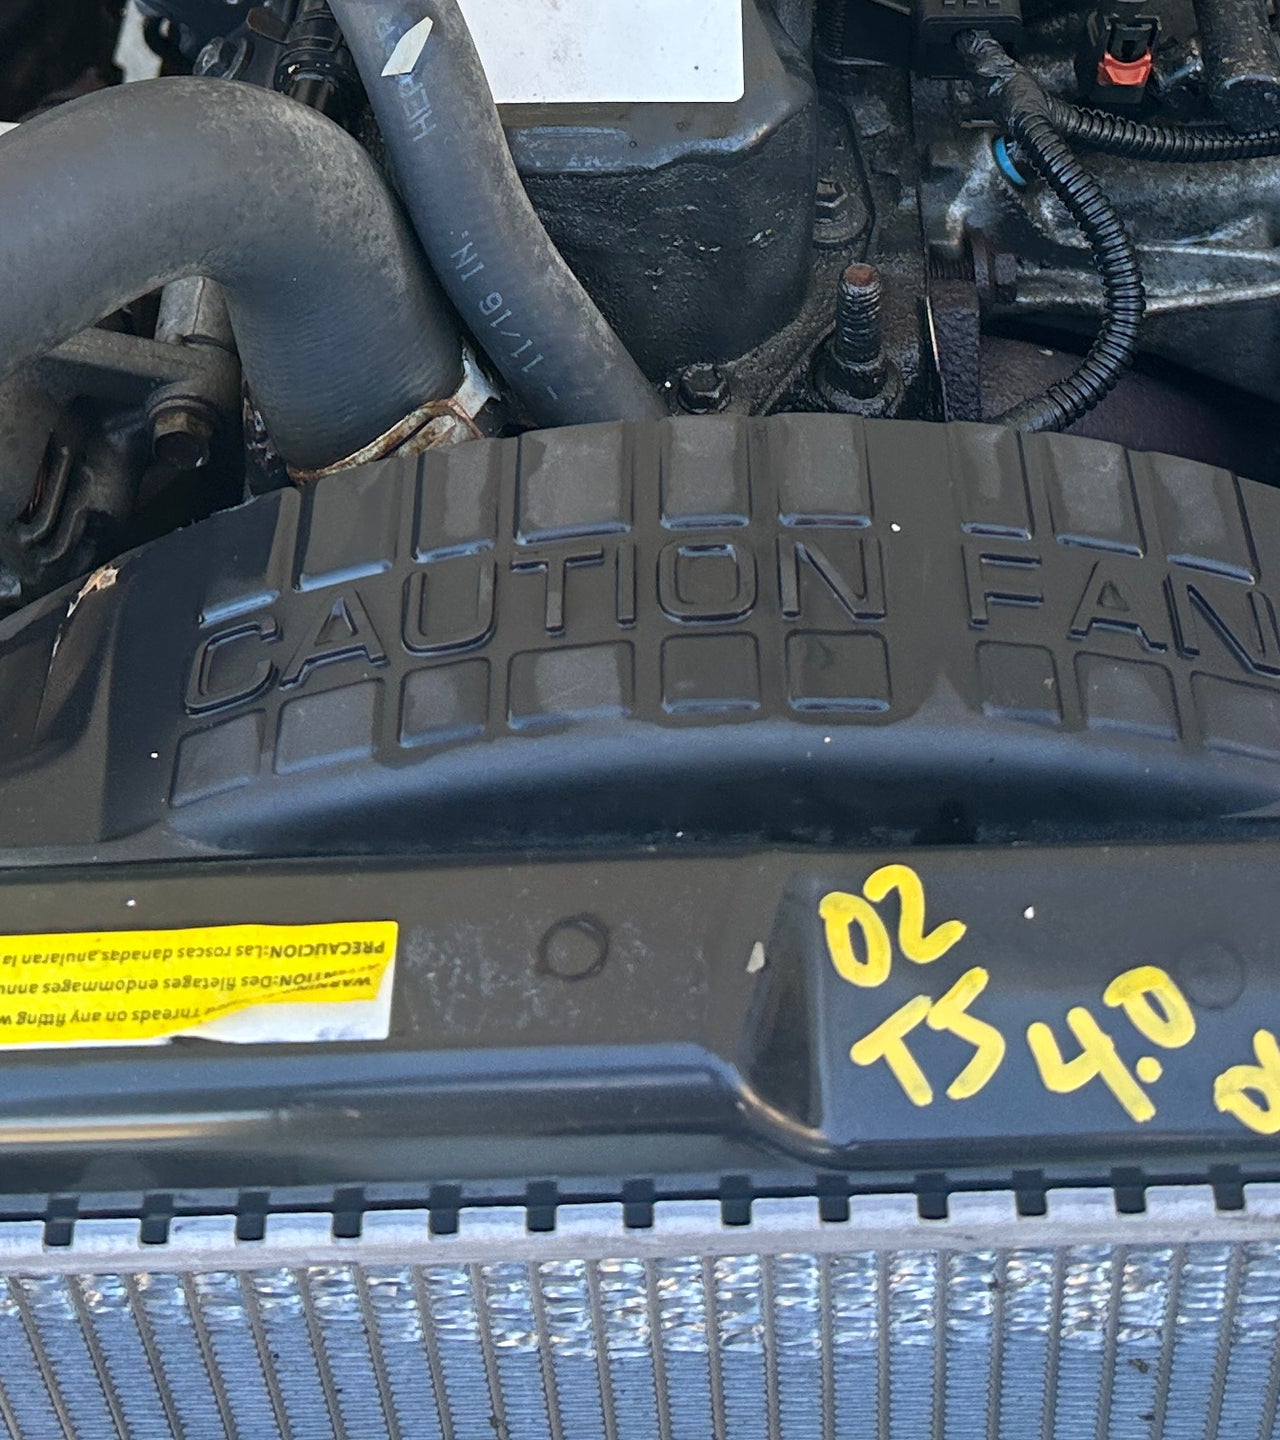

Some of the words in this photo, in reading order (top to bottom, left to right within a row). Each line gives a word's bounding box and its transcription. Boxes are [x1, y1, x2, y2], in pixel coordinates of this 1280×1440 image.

[478, 290, 545, 374] 11/16
[183, 535, 890, 718] CAUTION
[818, 863, 967, 988] 02
[178, 944, 232, 958] roscas
[3, 953, 17, 968] la
[42, 978, 159, 996] endommages
[164, 975, 236, 991] filetages
[16, 1010, 67, 1027] fitting
[70, 1010, 103, 1025] any
[106, 1010, 128, 1023] on
[132, 1007, 200, 1023] Threads
[1025, 964, 1197, 1124] 4.0
